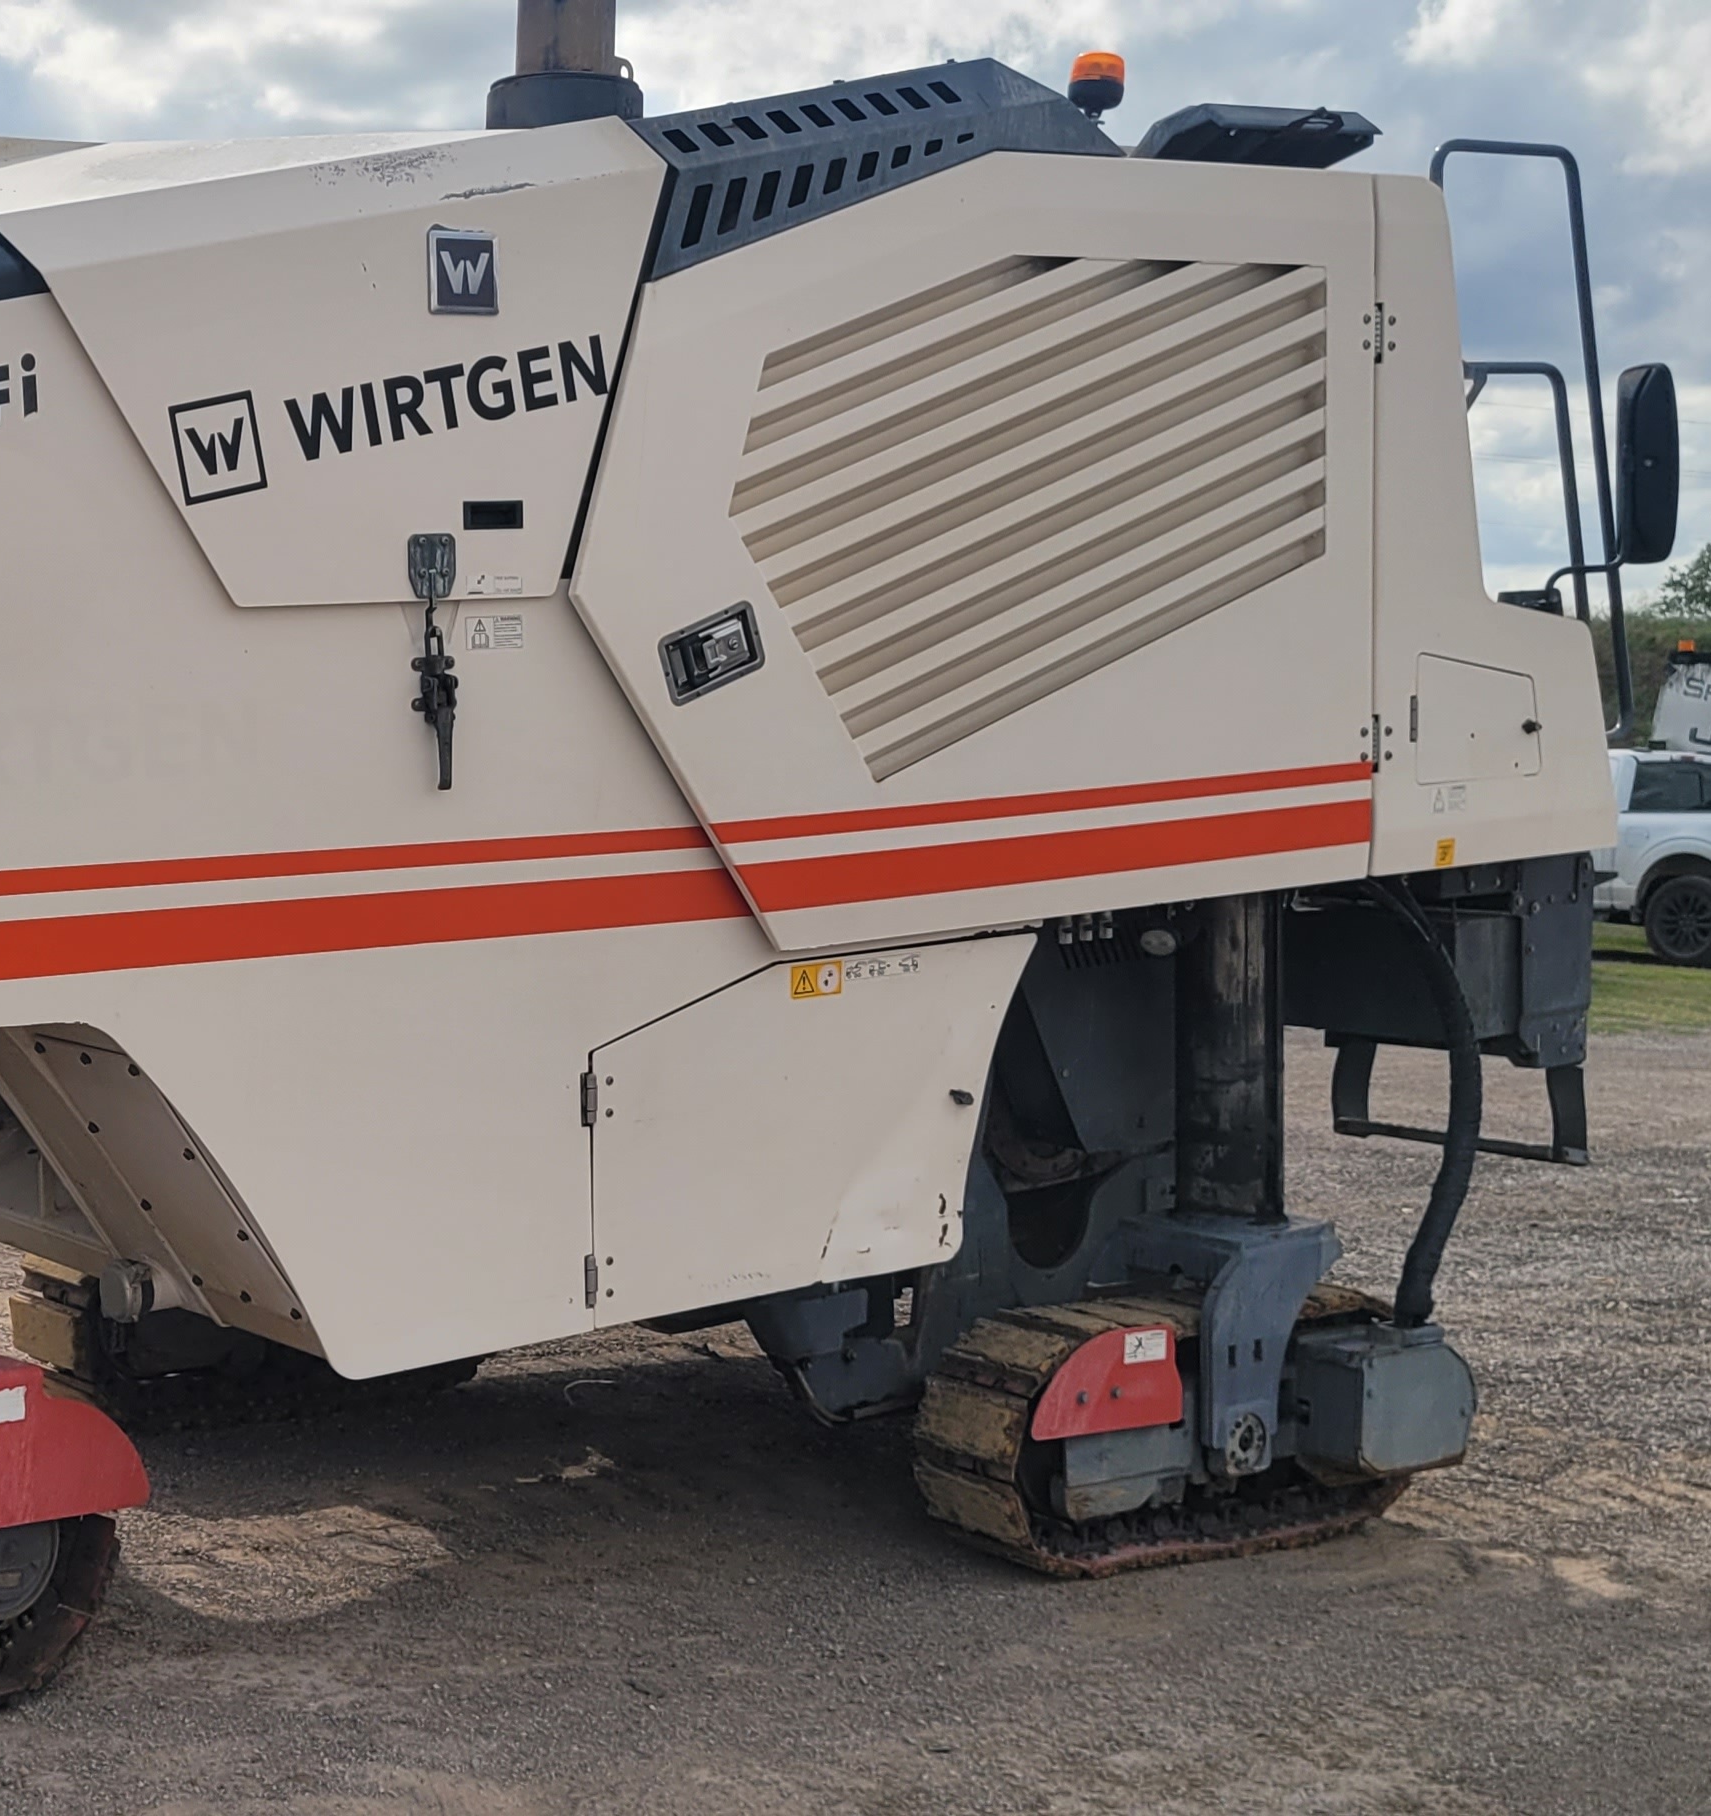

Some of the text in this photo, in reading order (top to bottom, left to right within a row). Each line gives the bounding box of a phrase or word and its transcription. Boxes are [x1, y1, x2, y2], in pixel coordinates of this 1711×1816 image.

[439, 250, 490, 294] W
[184, 334, 609, 476] W WIRTGEN
[1683, 677, 1711, 701] S
